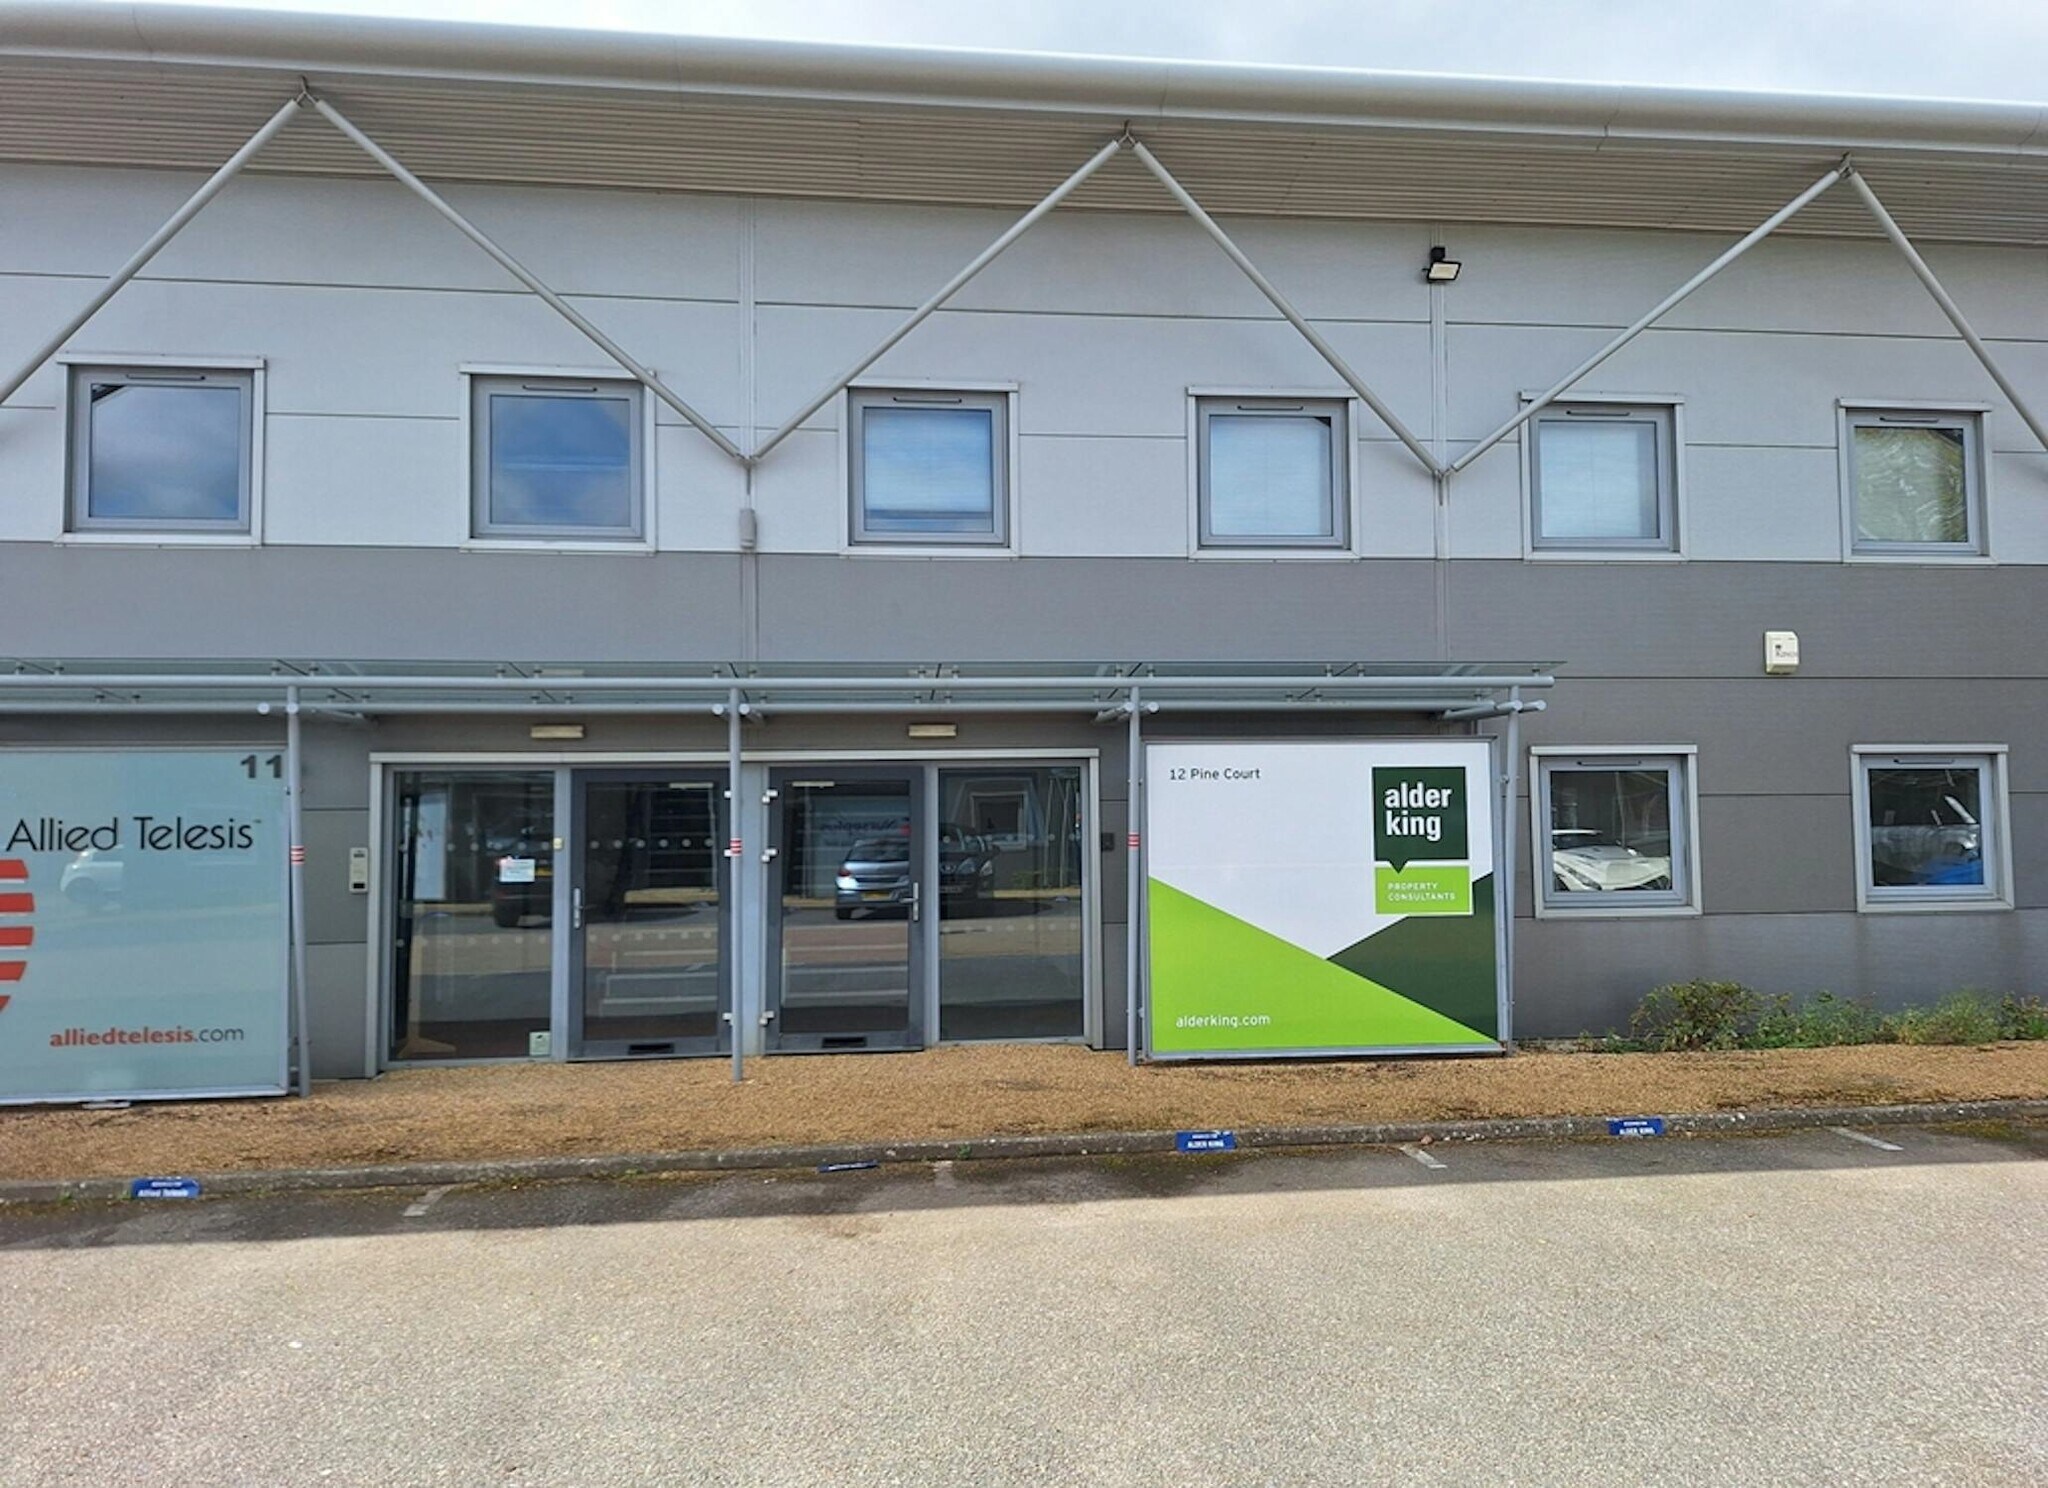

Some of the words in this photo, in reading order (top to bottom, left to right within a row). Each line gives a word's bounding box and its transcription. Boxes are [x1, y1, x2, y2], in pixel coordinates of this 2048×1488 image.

[240, 754, 282, 779] 11
[1169, 768, 1186, 780] 12
[1190, 768, 1220, 780] Pine
[1223, 767, 1261, 780] Court
[1384, 782, 1452, 808] alder
[6, 817, 119, 852] Allied
[133, 817, 254, 850] Telesis
[1386, 810, 1442, 841] king
[1387, 882, 1438, 891] PROPERTY
[1387, 892, 1456, 901] CONSULTANTS
[1175, 1013, 1272, 1029] alderking.com
[49, 1025, 245, 1047] alliedtelesis.com
